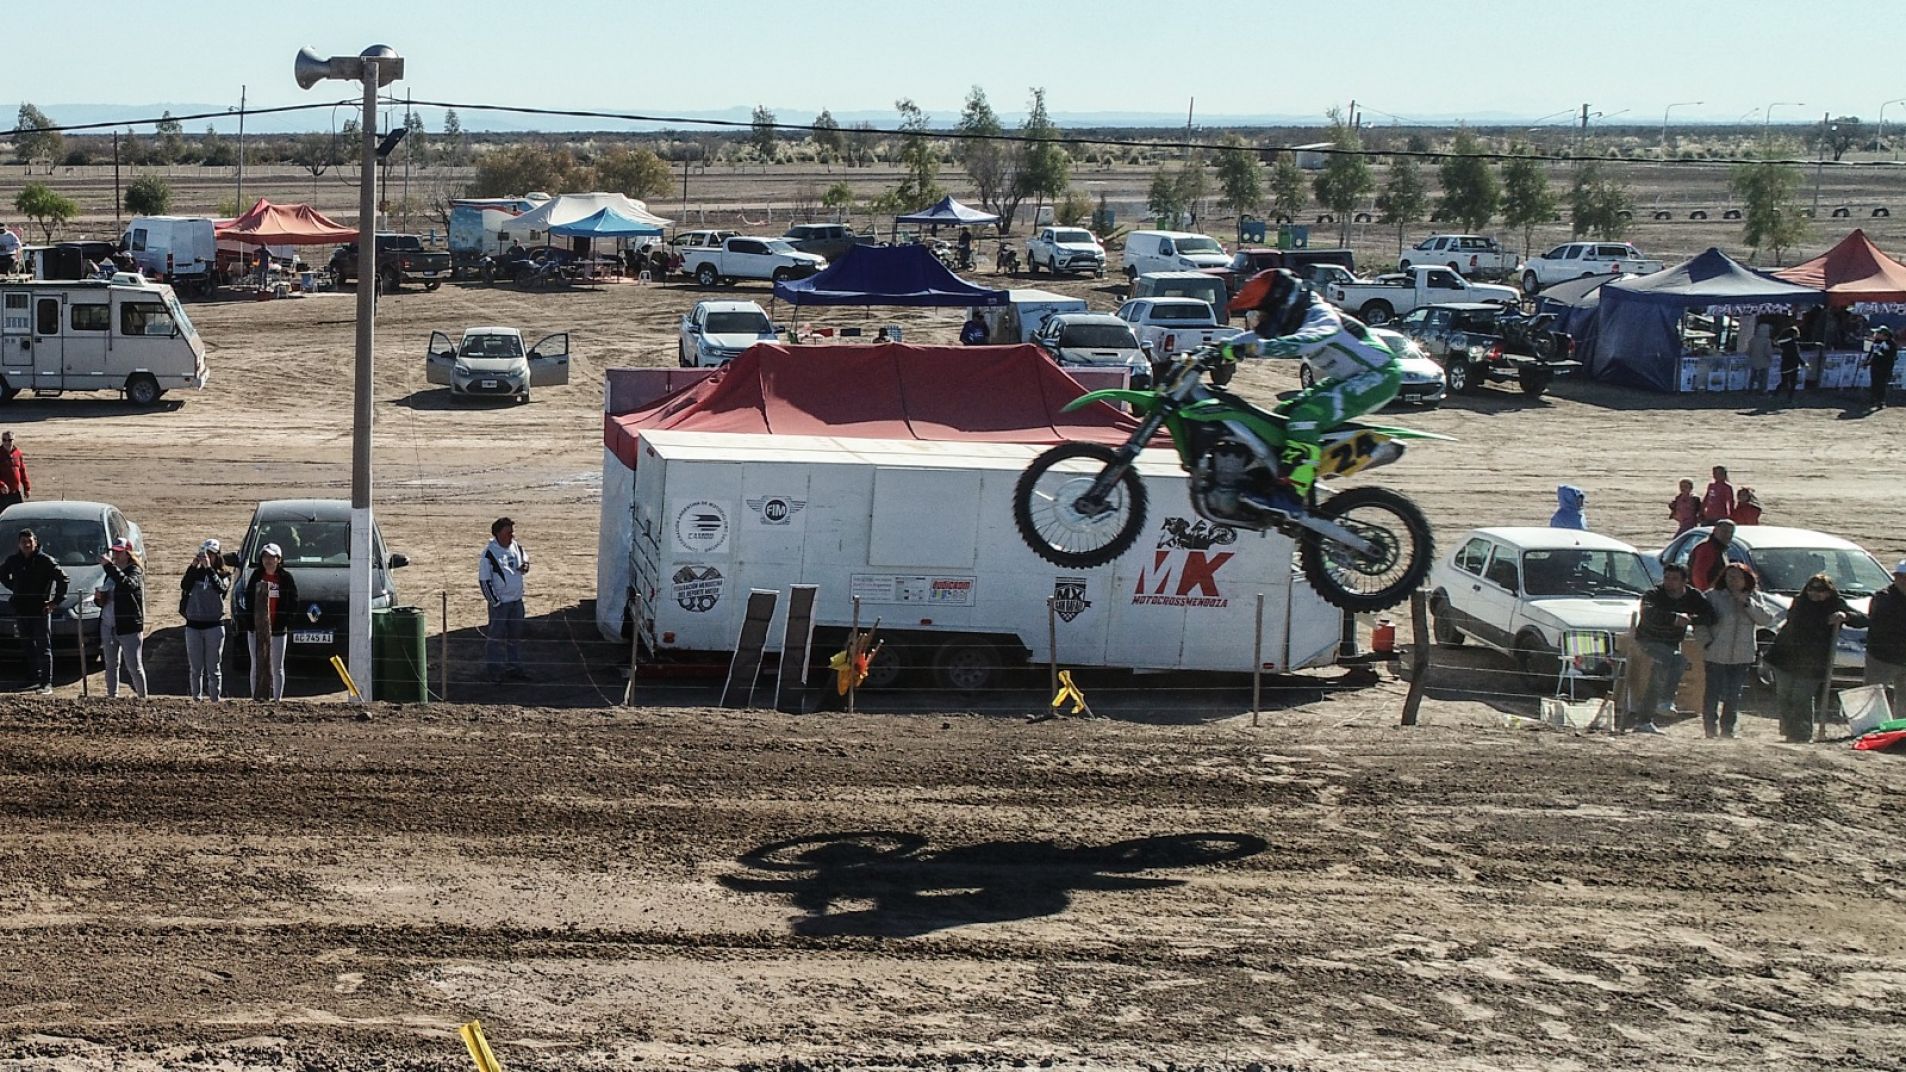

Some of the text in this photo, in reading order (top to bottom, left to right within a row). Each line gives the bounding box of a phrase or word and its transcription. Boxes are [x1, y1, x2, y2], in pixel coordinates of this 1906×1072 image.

[766, 503, 787, 517] FIM
[1056, 588, 1084, 600] MX
[1131, 596, 1228, 607] MOTOCROSSMENDOZA
